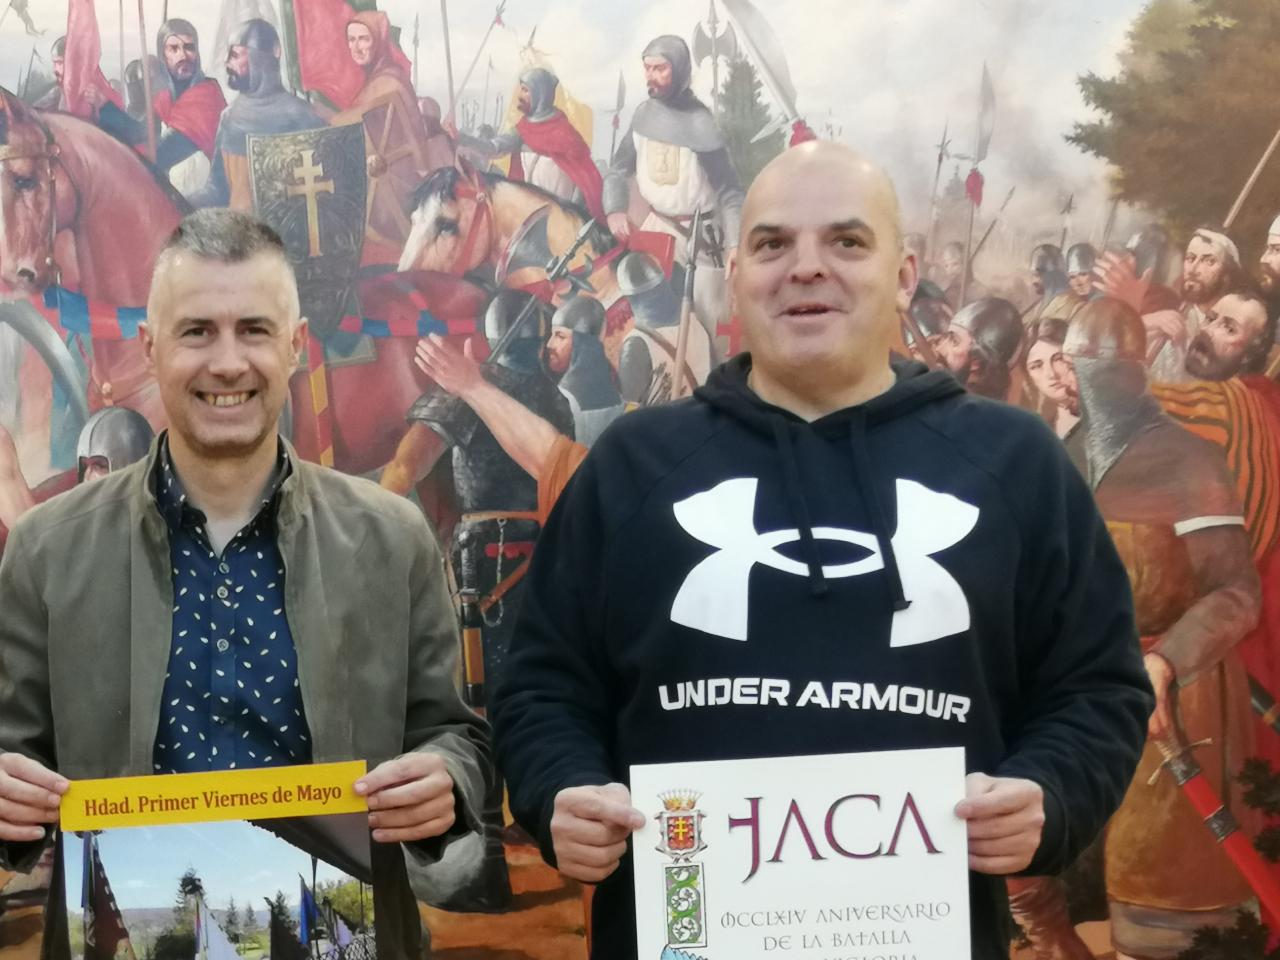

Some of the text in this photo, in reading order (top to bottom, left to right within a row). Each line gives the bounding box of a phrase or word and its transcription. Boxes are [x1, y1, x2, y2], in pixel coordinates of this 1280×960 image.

[658, 677, 971, 723] UNDER ARMOUR
[84, 784, 342, 816] Hdad. Primer Viernes de Mayo
[728, 792, 943, 883] JACA
[816, 902, 951, 923] ANIVERSARIO
[763, 929, 912, 951] DE LA BATALLA
